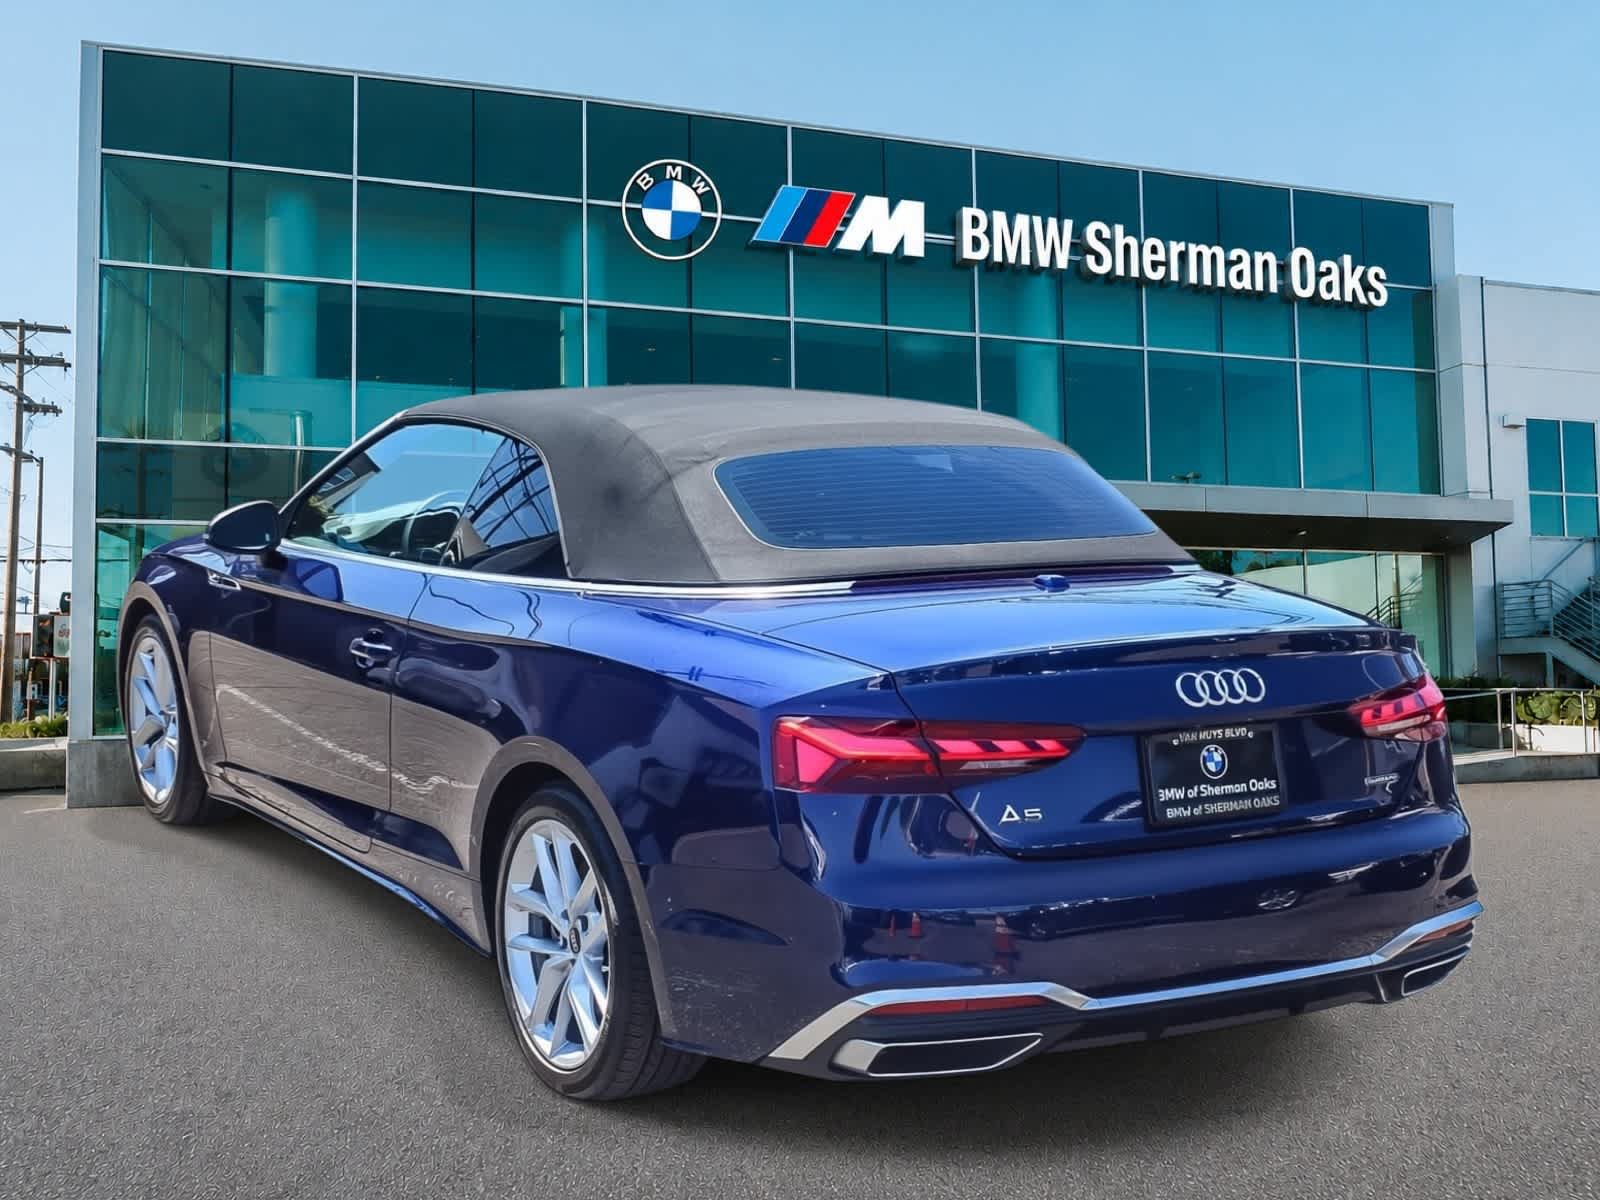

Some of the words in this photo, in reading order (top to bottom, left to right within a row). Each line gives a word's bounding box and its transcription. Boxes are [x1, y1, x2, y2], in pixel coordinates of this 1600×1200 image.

[636, 165, 711, 196] BMW
[834, 195, 925, 257] M
[960, 206, 1073, 269] BMW
[1084, 220, 1278, 293] Sherman
[1289, 247, 1389, 307] Oaks
[1158, 786, 1185, 801] BMW
[1187, 785, 1198, 798] of
[1200, 782, 1247, 797] Sherman
[1249, 778, 1277, 791] Oaks
[998, 804, 1043, 825] A5
[1166, 806, 1191, 818] BMW
[1193, 804, 1202, 815] of
[1203, 799, 1252, 814] SHERMAN
[1253, 796, 1280, 808] OAKS
